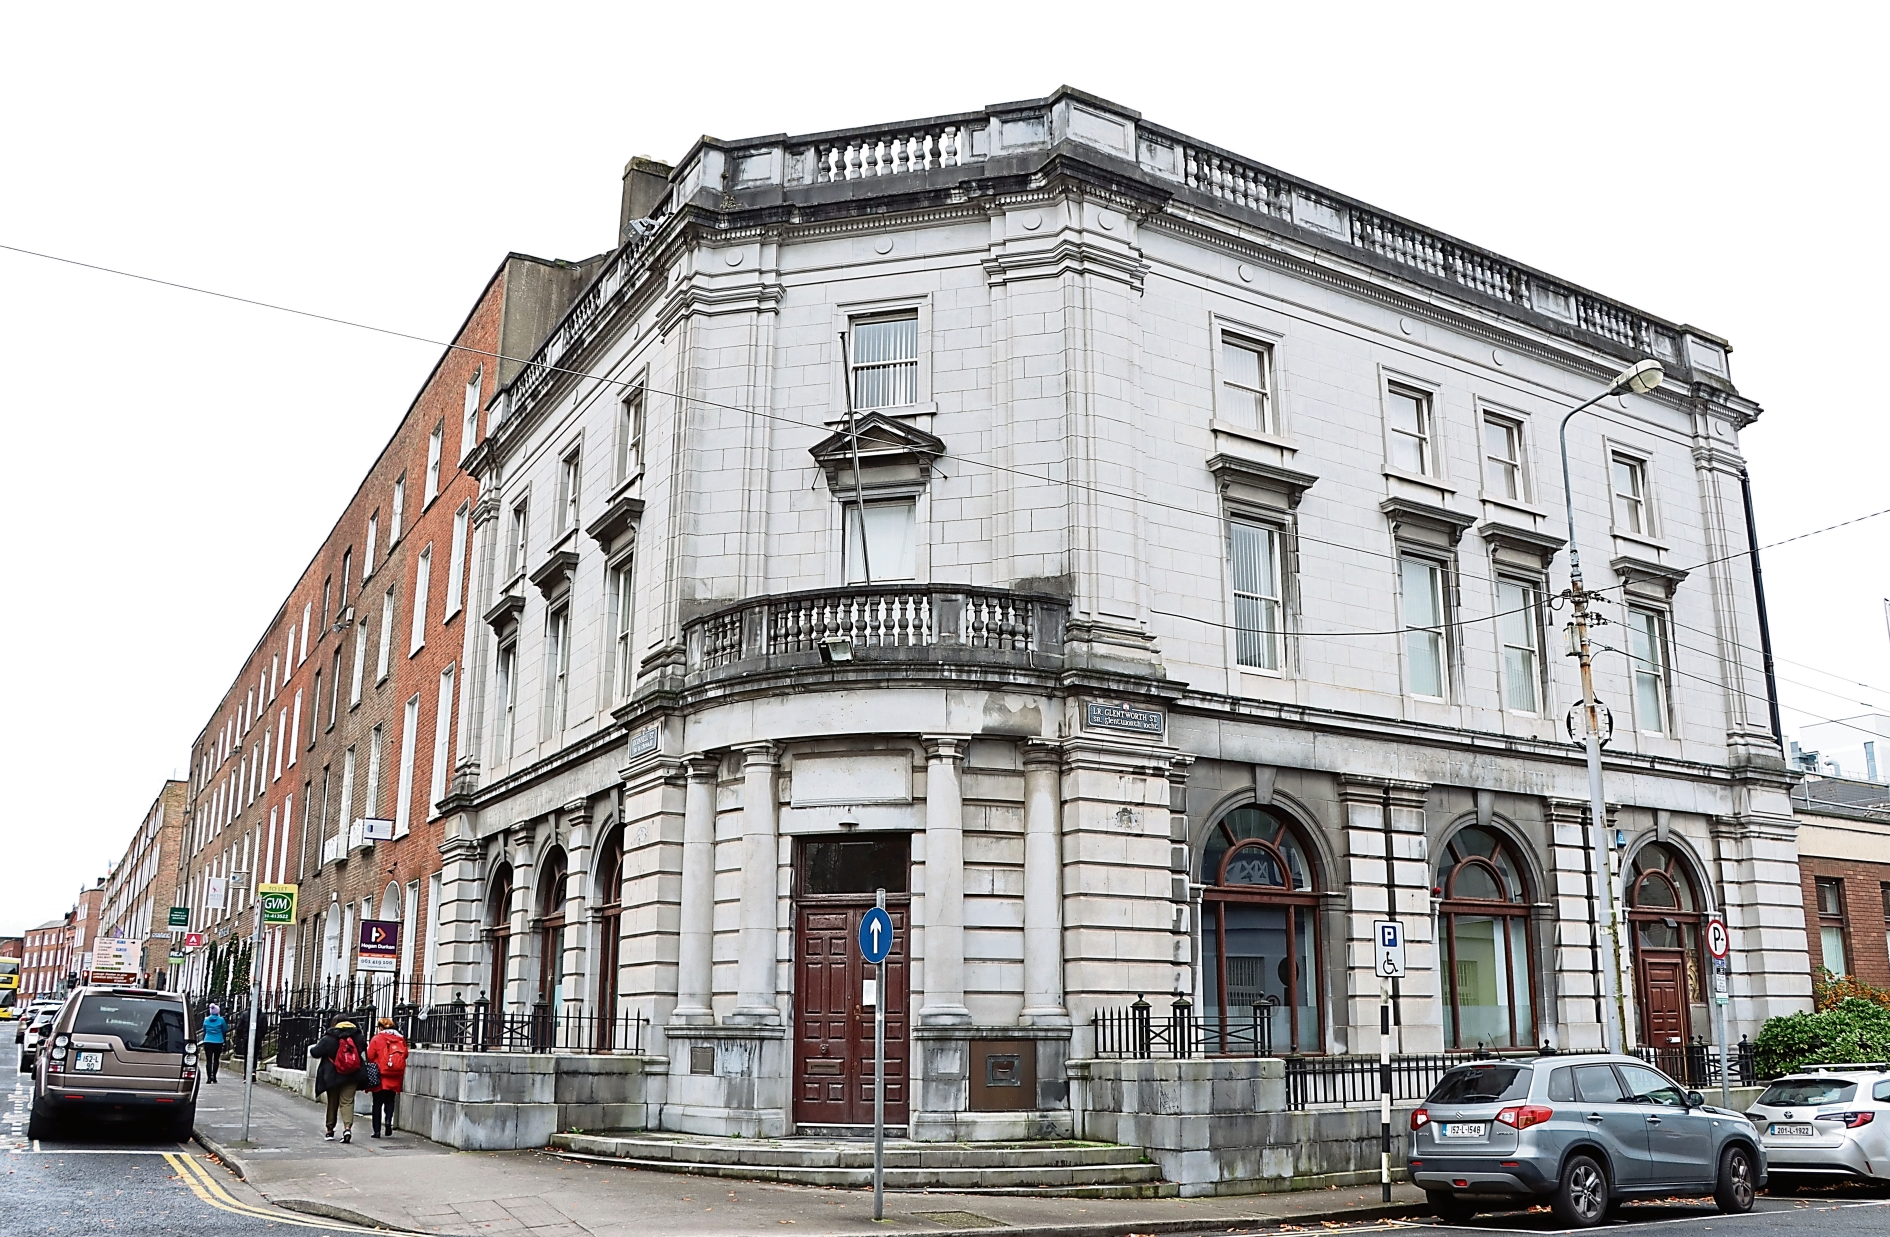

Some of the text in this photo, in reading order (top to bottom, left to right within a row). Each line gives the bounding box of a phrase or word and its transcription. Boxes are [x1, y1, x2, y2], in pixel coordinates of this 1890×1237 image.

[1105, 709, 1147, 721] GLENTWORTH
[265, 897, 288, 910] GVM
[1385, 928, 1394, 945] P
[83, 1055, 99, 1063] 152-L
[1451, 1125, 1481, 1134] 152-L-1548
[1777, 1127, 1809, 1135] 201-L-1922
